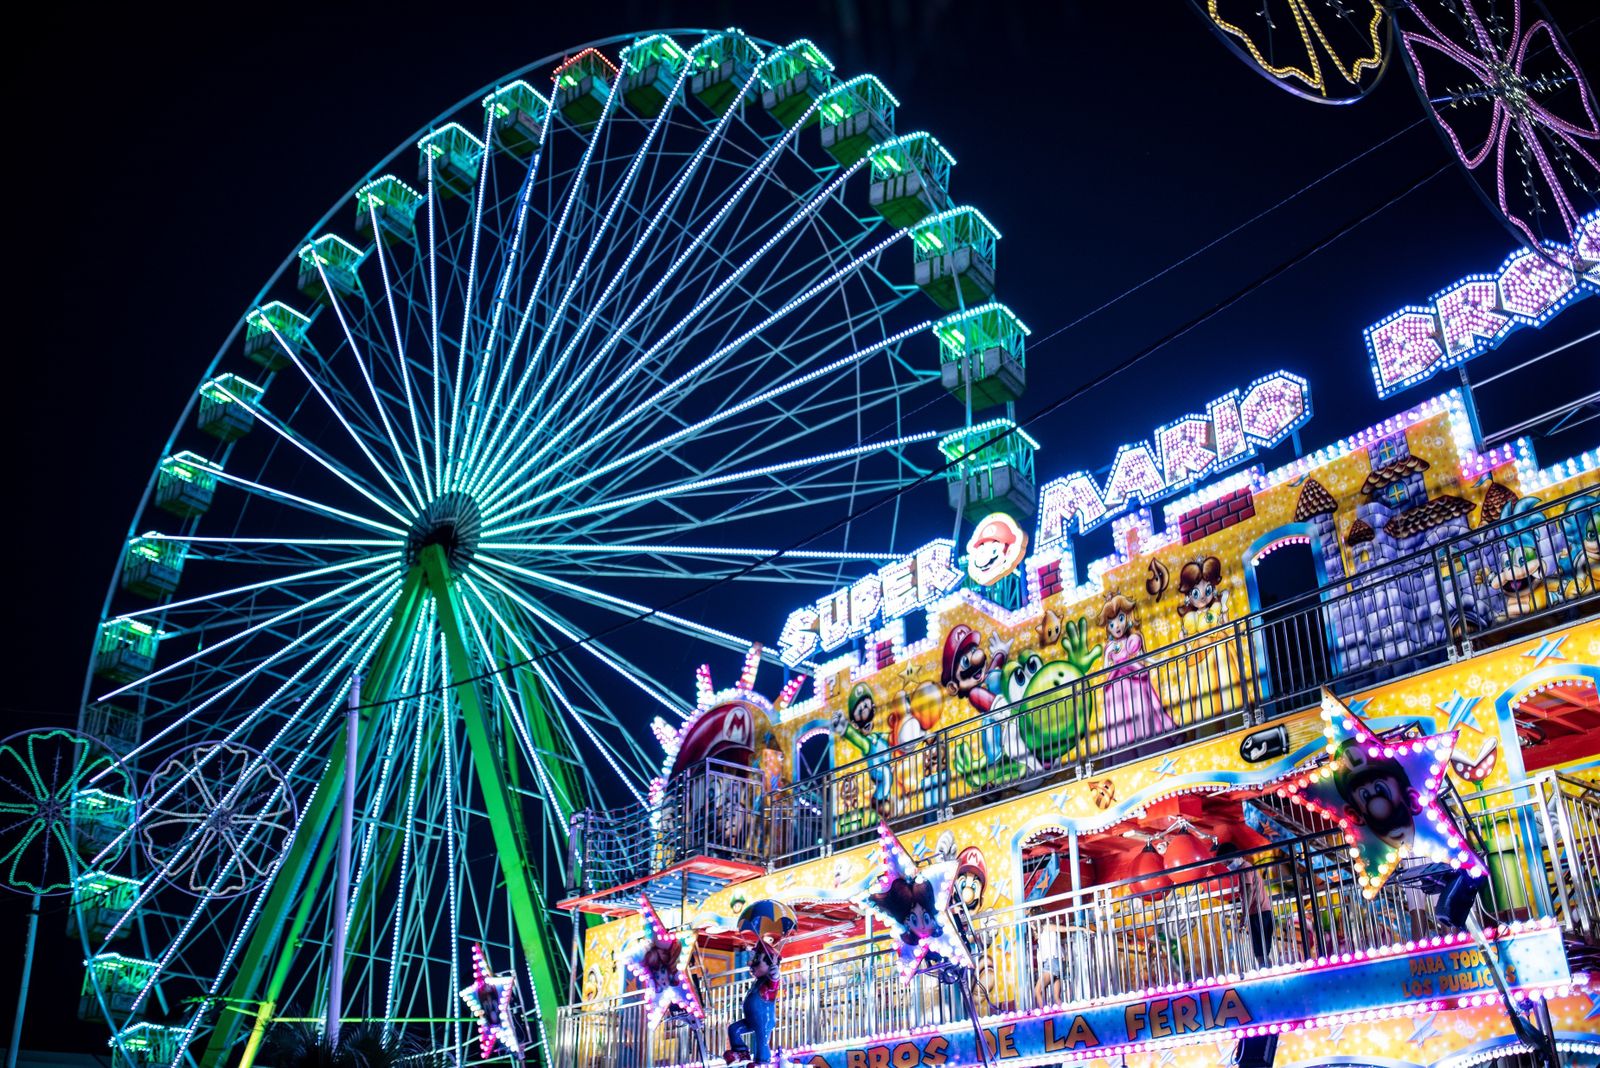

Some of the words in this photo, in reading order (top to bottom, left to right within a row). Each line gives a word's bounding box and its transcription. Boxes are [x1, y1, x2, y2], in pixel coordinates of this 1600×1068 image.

[777, 538, 965, 668] SUPER
[1035, 369, 1314, 555] MARIO
[1402, 980, 1433, 998] LOS
[1439, 964, 1517, 993] PUBLICS
[1409, 955, 1446, 976] PARA
[1044, 1014, 1100, 1053] LA
[1124, 988, 1254, 1042] FERIA
